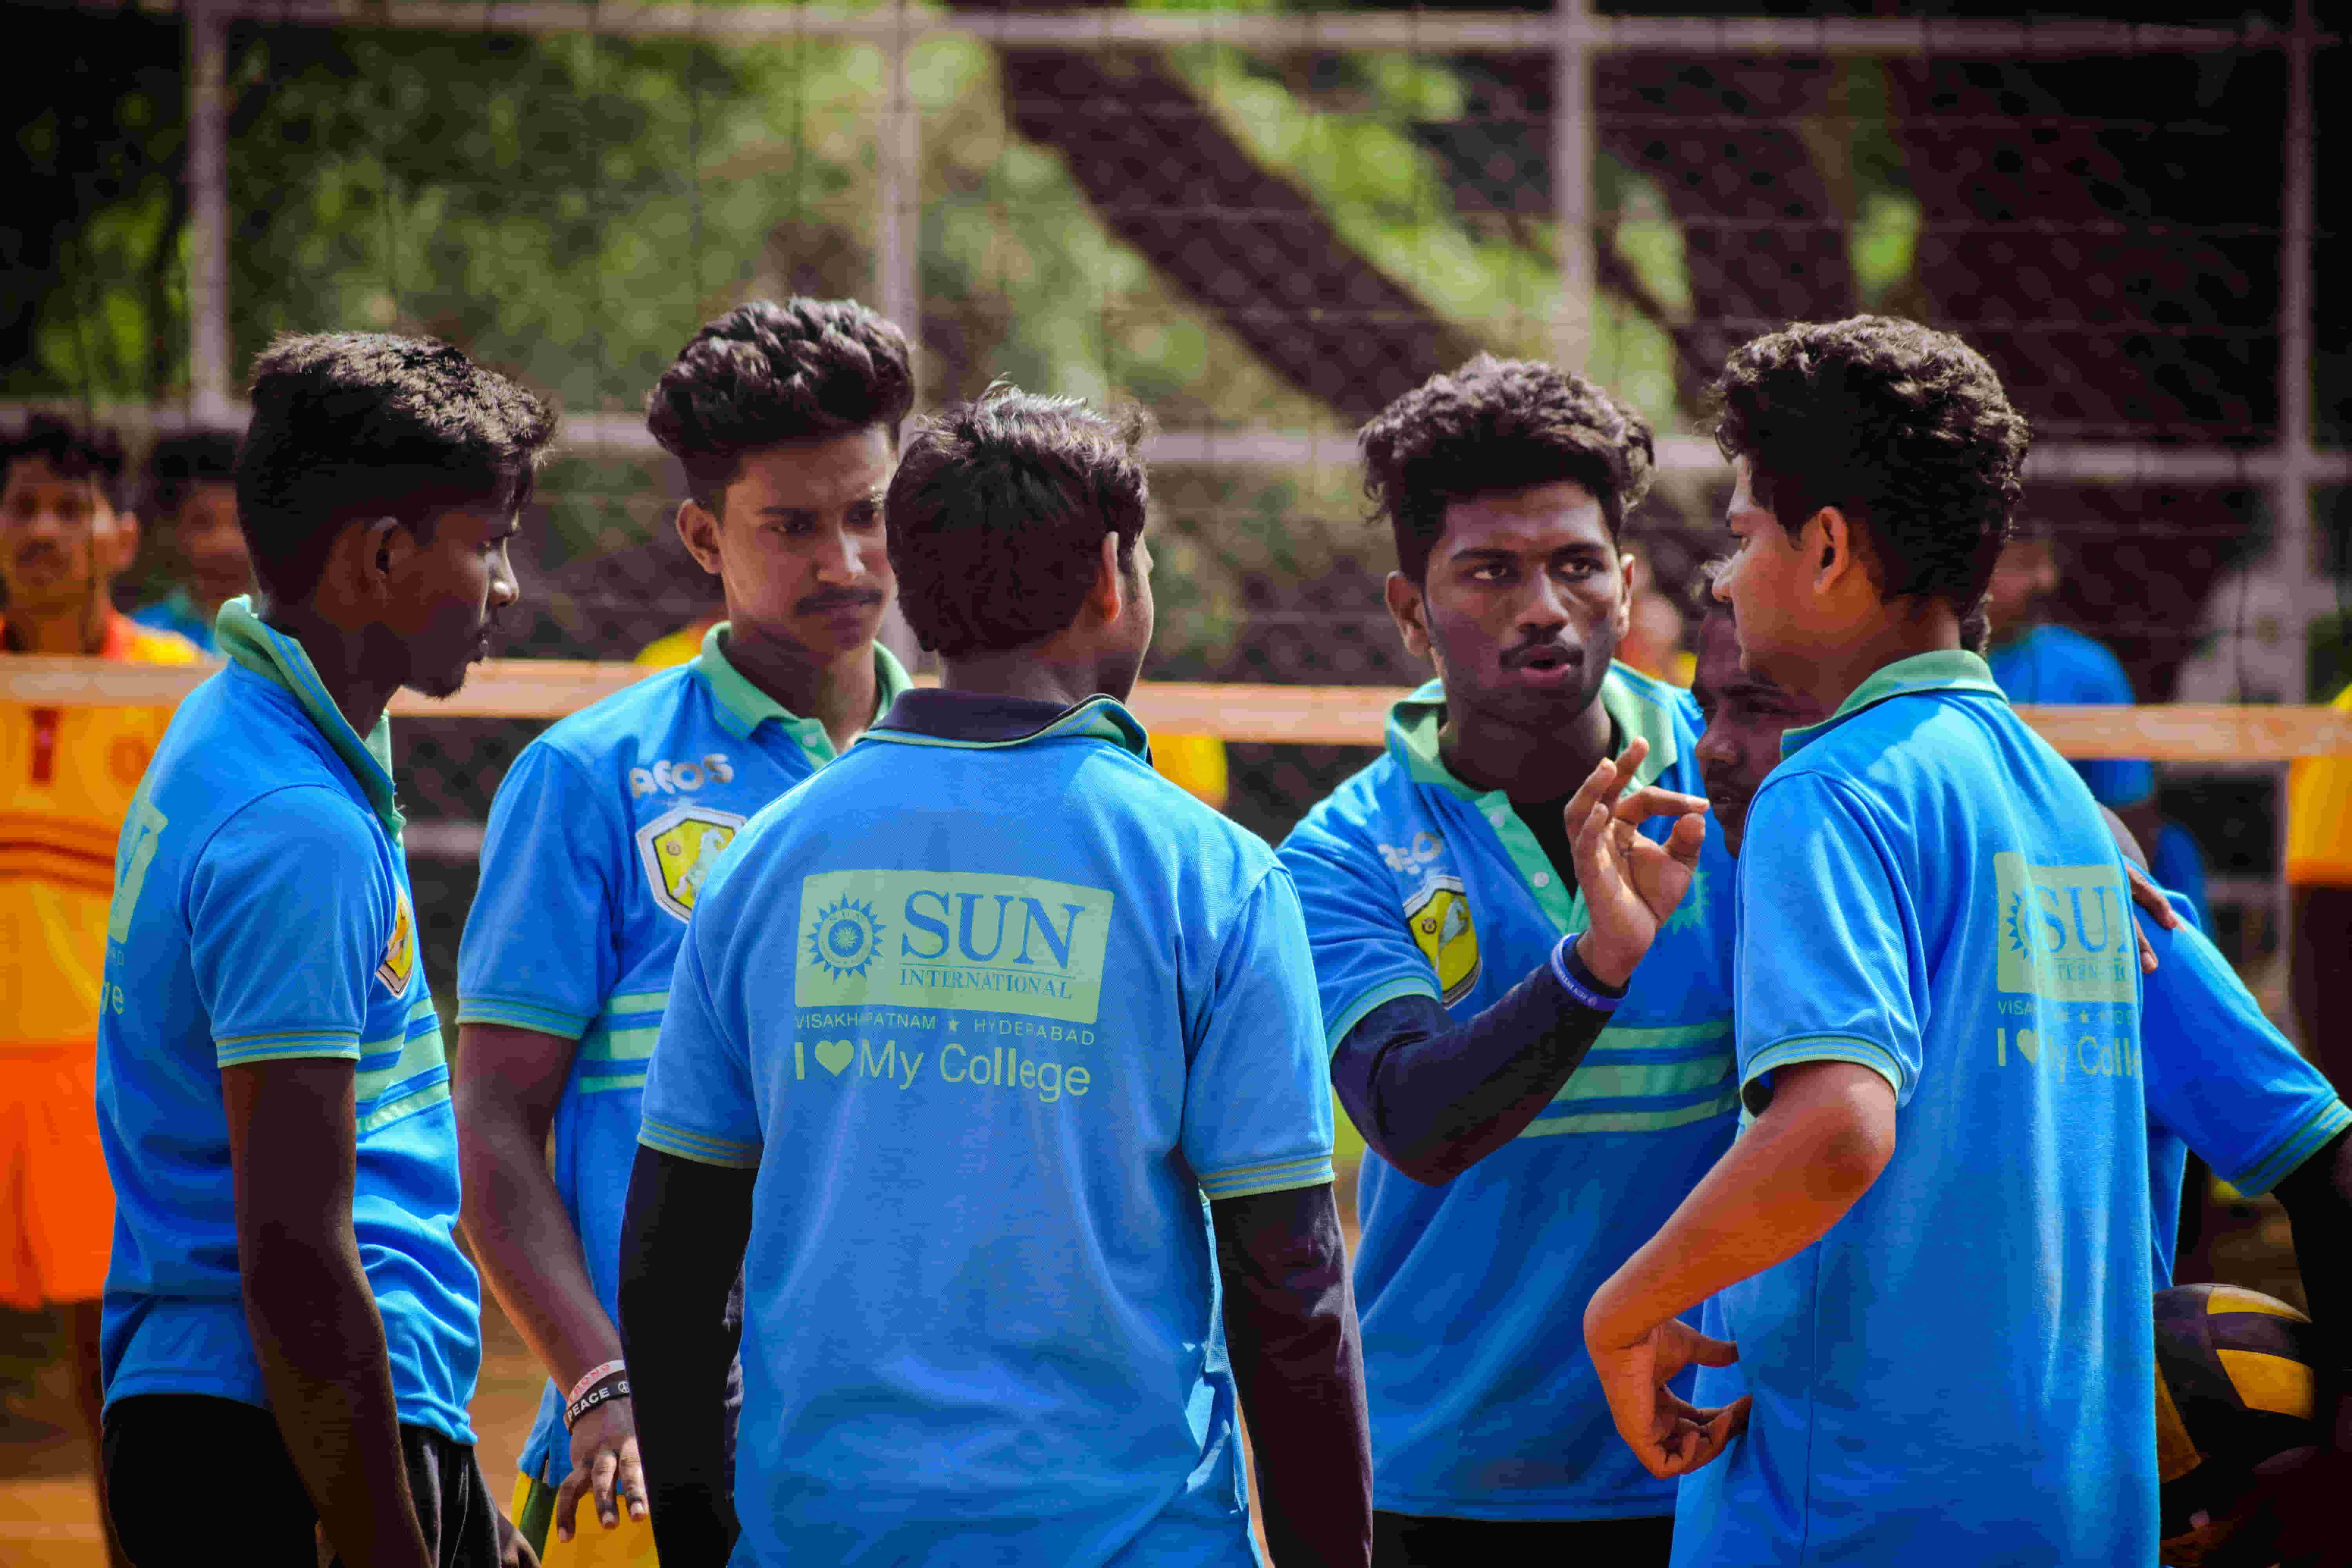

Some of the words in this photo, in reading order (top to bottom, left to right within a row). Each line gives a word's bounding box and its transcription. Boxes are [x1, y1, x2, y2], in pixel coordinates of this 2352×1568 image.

[901, 889, 1085, 969] SUN
[899, 968, 1073, 1001] INTERNATIONAL
[795, 1011, 937, 1029] VISAKHPATNAM
[975, 1018, 1095, 1046] HYDERABAD
[1997, 1027, 2007, 1067] I
[794, 1041, 805, 1080] I
[860, 1039, 925, 1091] My
[940, 1043, 1091, 1103] College
[568, 1387, 610, 1421] PEACE
